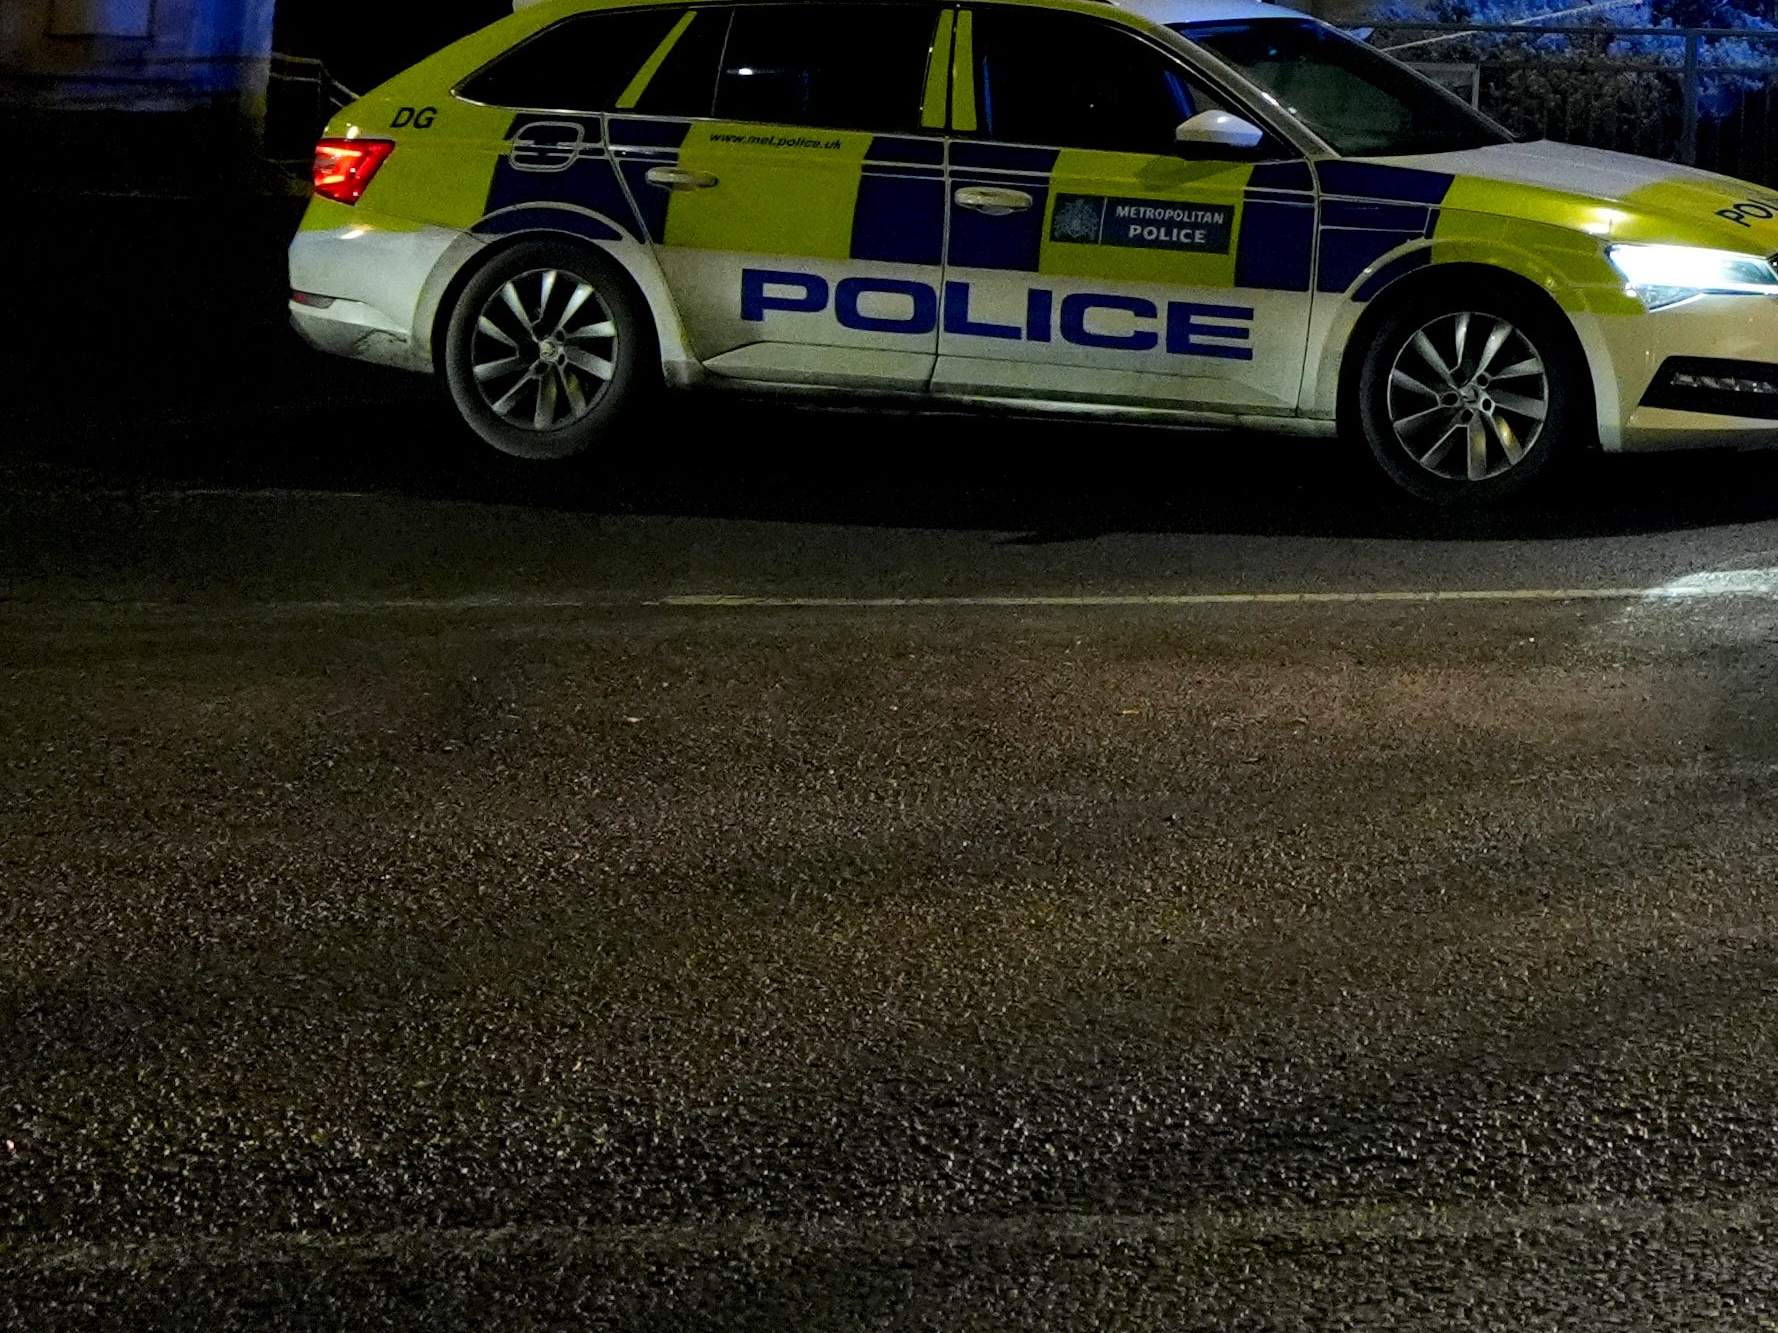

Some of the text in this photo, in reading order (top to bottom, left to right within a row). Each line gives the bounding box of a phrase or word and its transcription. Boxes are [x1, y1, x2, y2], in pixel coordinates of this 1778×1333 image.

[390, 106, 438, 129] DG
[1116, 204, 1225, 224] METROPOLITAN
[1128, 224, 1206, 244] POLICE
[741, 268, 1255, 360] POLICE
